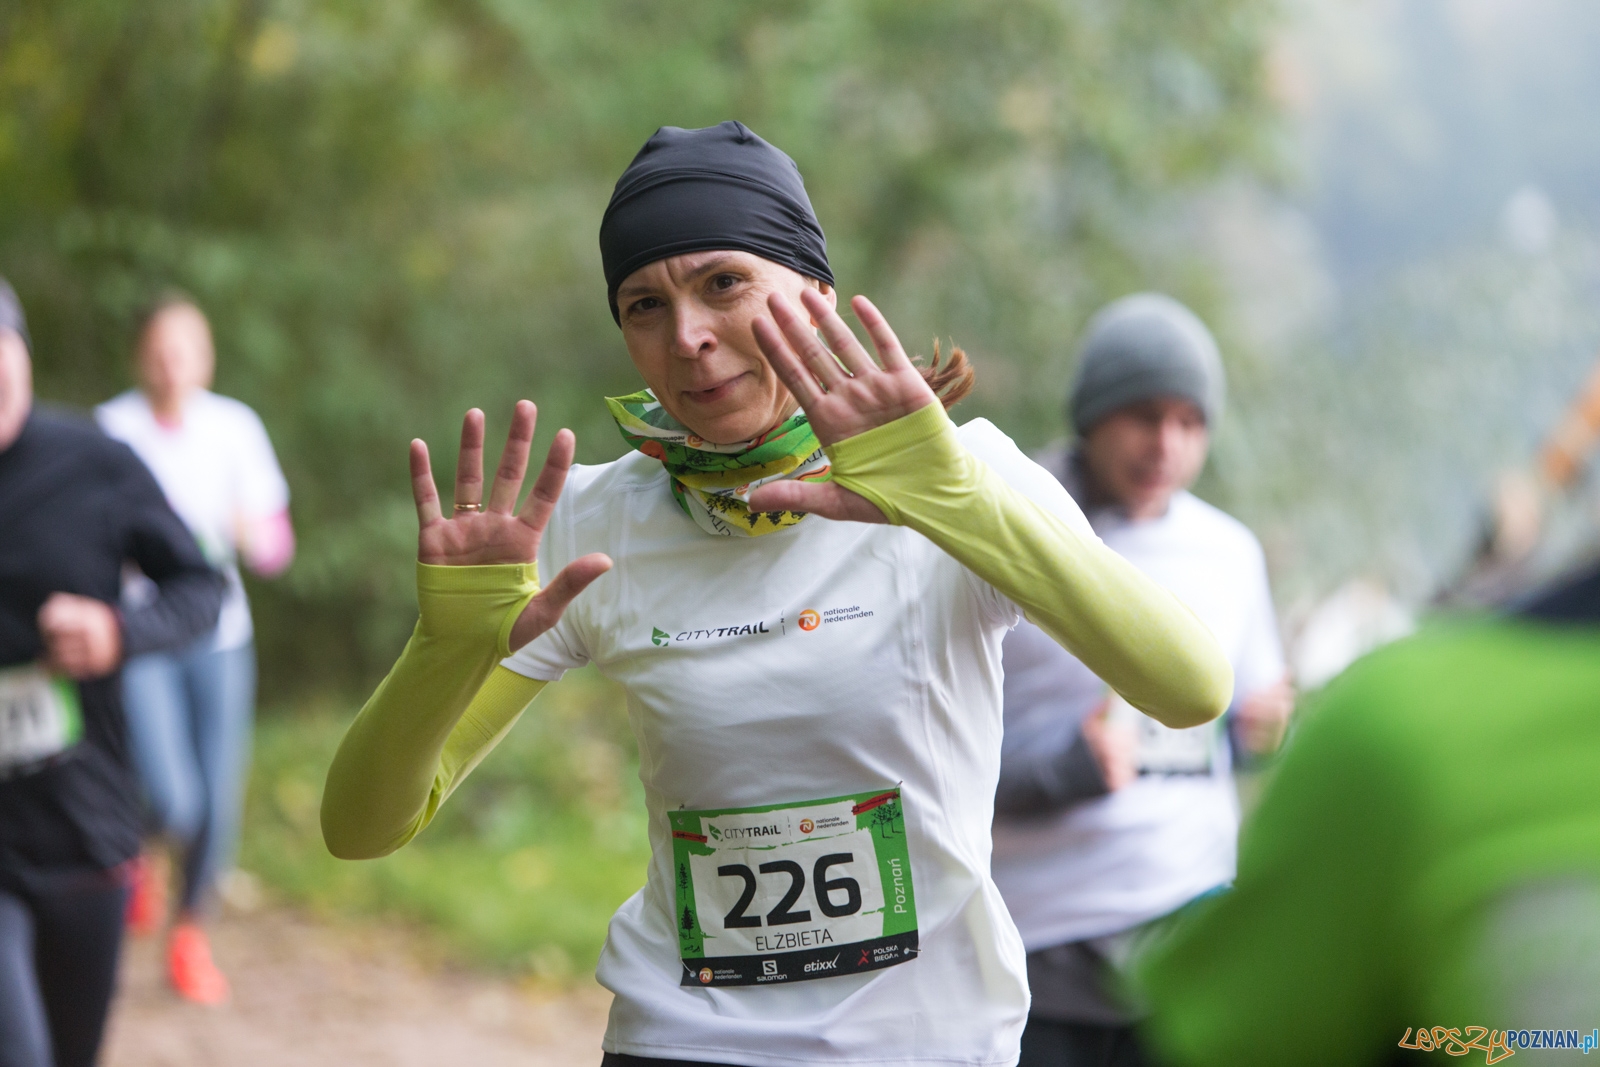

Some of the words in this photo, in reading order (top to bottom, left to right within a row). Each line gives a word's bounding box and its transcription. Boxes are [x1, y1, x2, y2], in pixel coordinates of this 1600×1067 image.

[823, 605, 861, 617] nationale
[823, 609, 874, 625] nederlanden
[815, 816, 840, 824] nationale
[816, 819, 850, 830] nederlanden
[717, 852, 863, 930] 226
[887, 857, 908, 915] Poznań
[755, 928, 834, 952] ELŻBIETA
[873, 944, 899, 956] POLSKA
[714, 973, 743, 981] nederlanden
[756, 974, 788, 983] salomon
